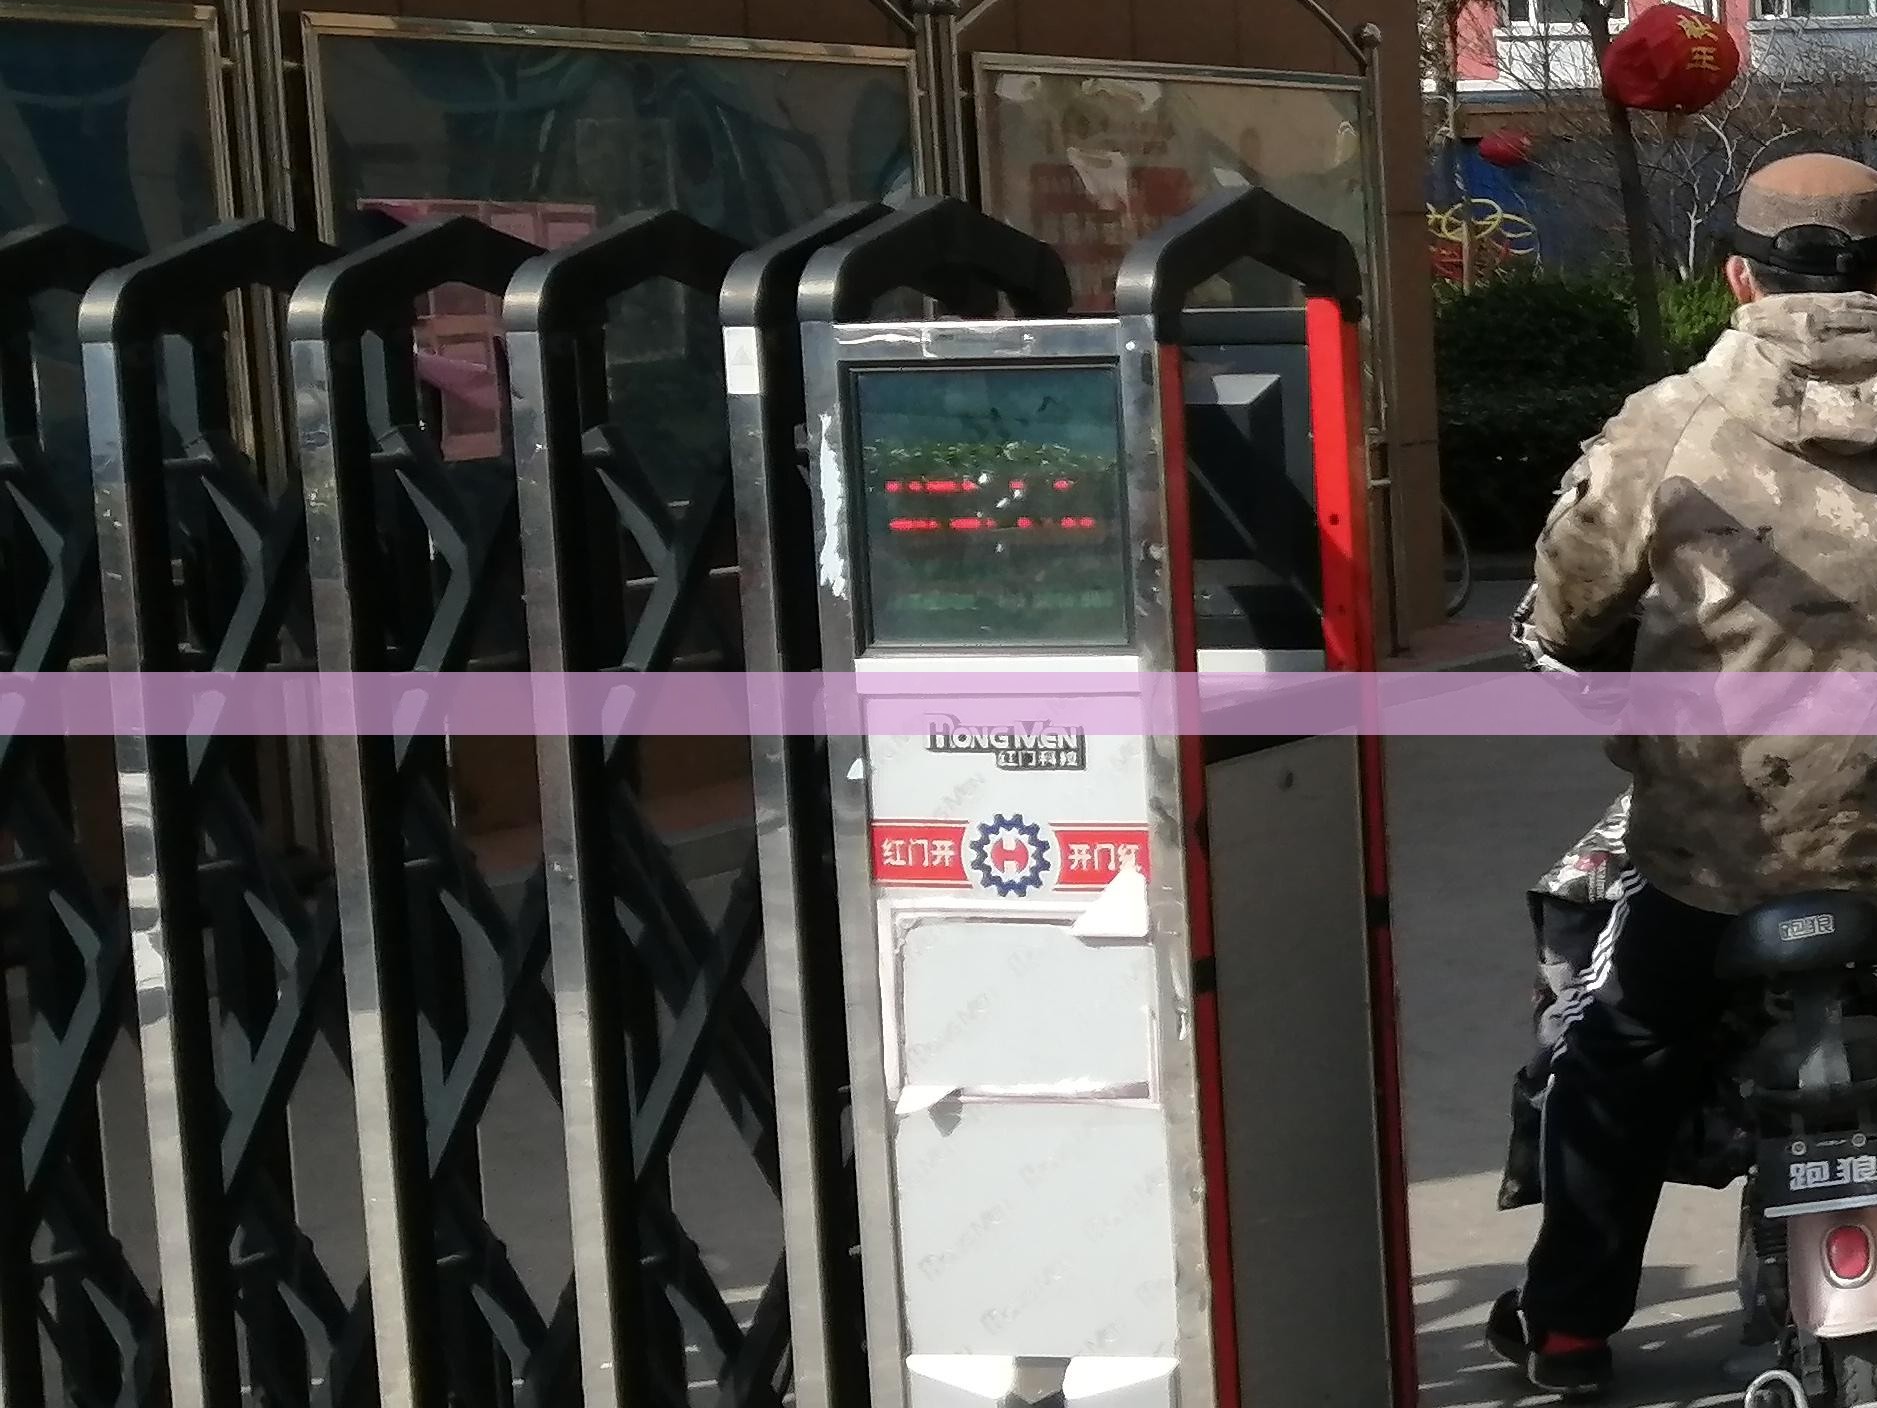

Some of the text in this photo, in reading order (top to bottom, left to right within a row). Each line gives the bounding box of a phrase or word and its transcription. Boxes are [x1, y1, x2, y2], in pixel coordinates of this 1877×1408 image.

[881, 838, 955, 867] 红门开
[1067, 843, 1142, 872] 开门红
